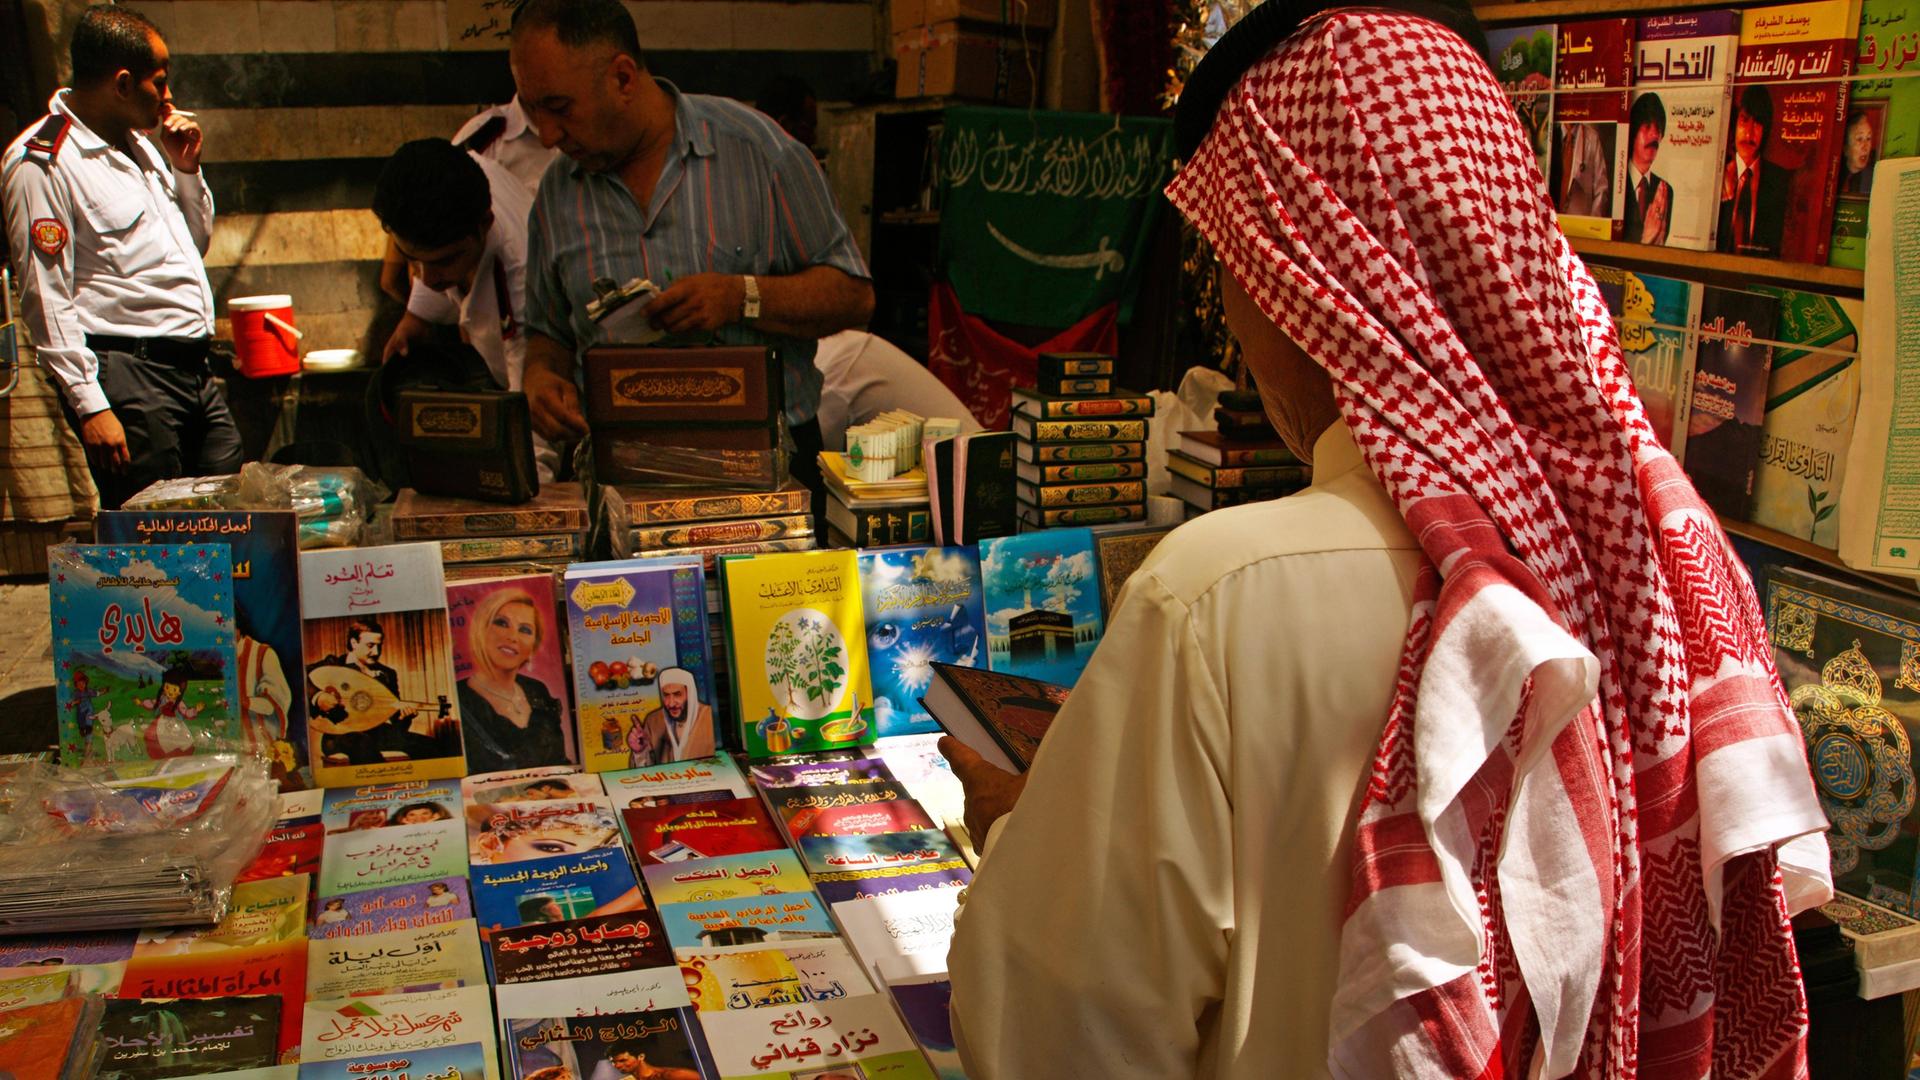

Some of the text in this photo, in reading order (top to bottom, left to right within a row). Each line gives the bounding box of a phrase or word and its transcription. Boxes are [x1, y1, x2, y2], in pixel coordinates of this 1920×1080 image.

[1636, 44, 1716, 82] التخاط
[1799, 44, 1833, 75] أنت
[1782, 111, 1824, 127] بالطريقة
[1781, 128, 1823, 143] الصينية
[136, 514, 252, 537] أجمل الحكايات العالمية
[100, 596, 185, 656] هايدي
[584, 610, 632, 632] الإسلامية
[610, 630, 652, 647] الجامعة
[489, 801, 596, 829] المكياج
[823, 848, 942, 867] علامات الساعة
[483, 860, 609, 887] واجبات الزوجة الجنسية
[672, 861, 781, 885] أجمل النكت
[498, 920, 651, 954] وصايا زوجية
[327, 947, 383, 966] ليلة
[519, 1016, 679, 1050] الزواج المثالي
[769, 1009, 833, 1035] روائع
[104, 1024, 255, 1049] تفسير الأحلا
[112, 1050, 150, 1061] سيرين
[151, 1047, 168, 1058] بن
[170, 1045, 199, 1055] محمد
[750, 1027, 880, 1071] نزار قباني
[345, 1058, 412, 1075] موسوعة
